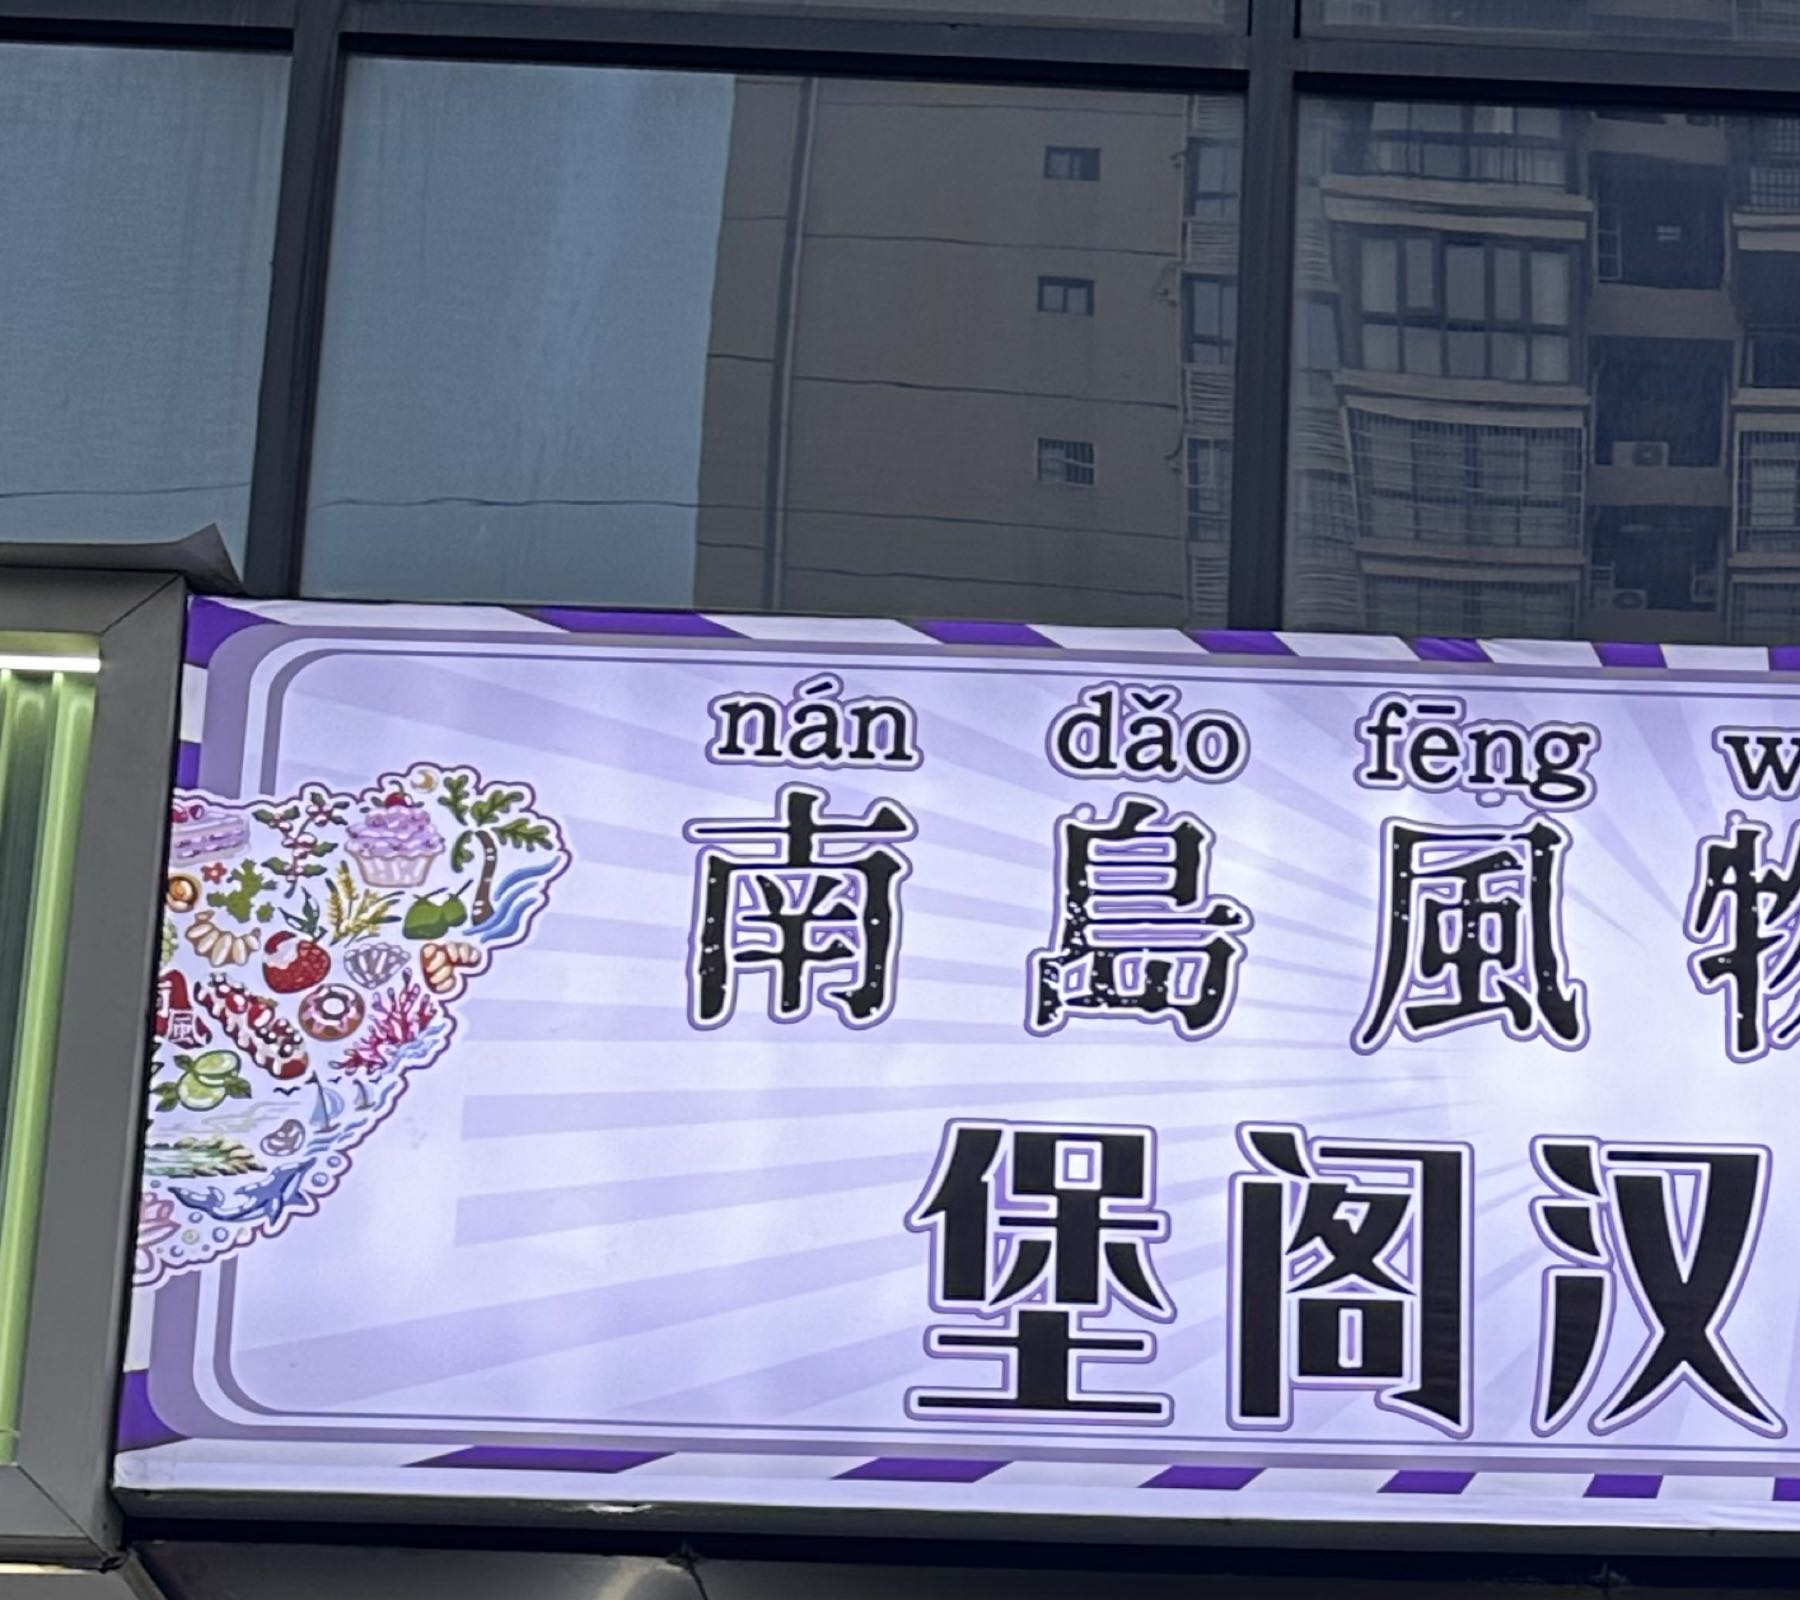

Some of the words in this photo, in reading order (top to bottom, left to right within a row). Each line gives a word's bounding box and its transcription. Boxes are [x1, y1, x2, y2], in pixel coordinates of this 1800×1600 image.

[717, 681, 914, 762] nán
[1057, 690, 1239, 774] dǎo
[1365, 701, 1591, 803] fēng
